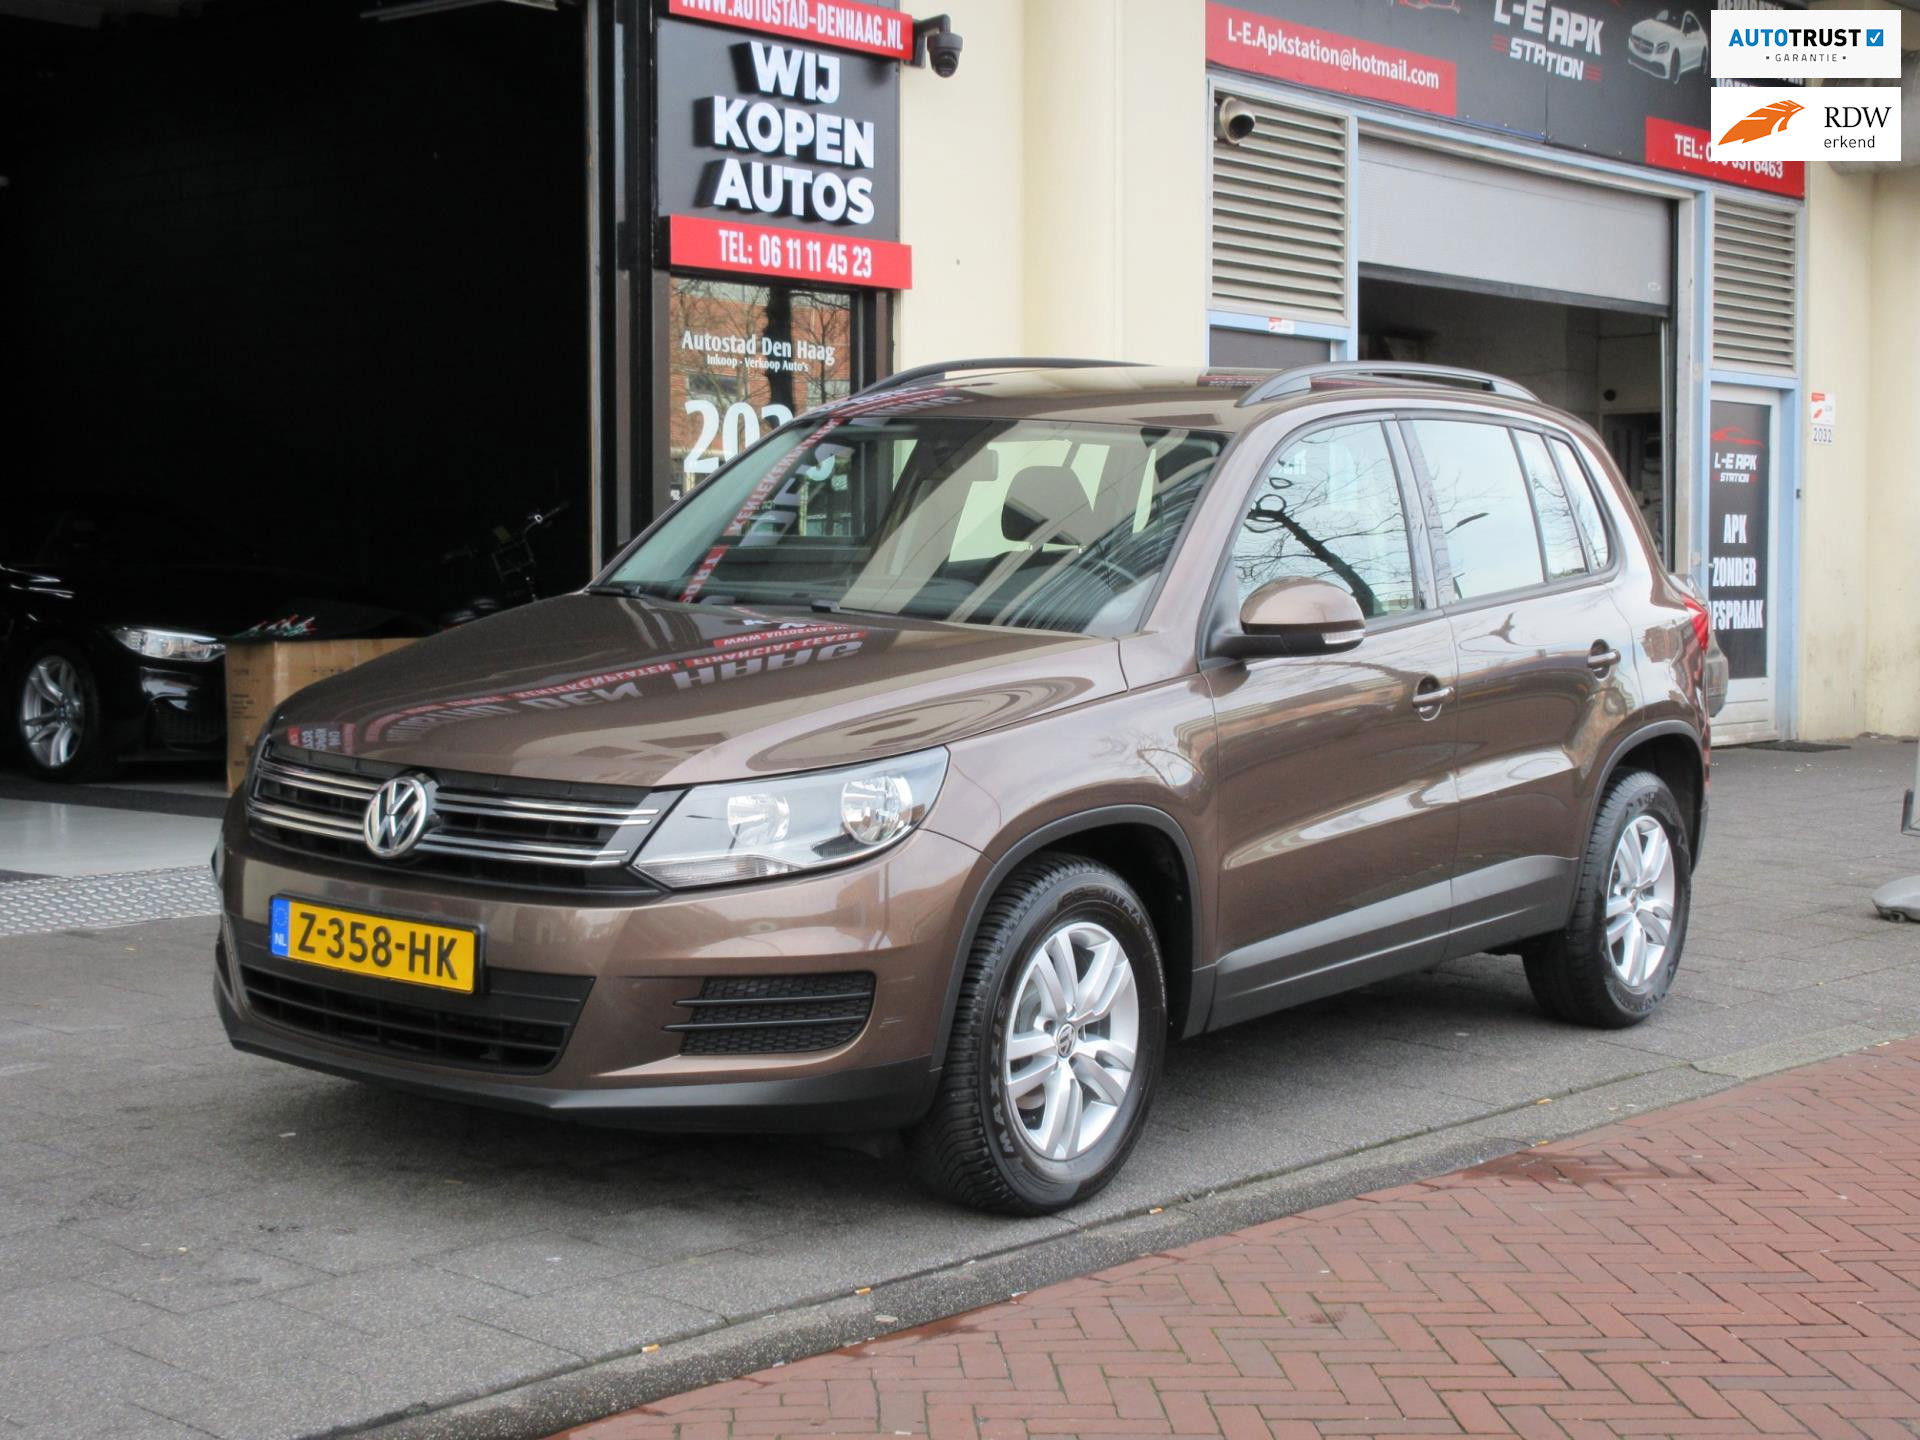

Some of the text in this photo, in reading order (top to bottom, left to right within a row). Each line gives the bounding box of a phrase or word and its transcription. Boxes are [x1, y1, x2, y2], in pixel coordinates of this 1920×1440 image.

[1493, 0, 1604, 55] L-E APK
[750, 40, 840, 104] WIJ
[1227, 17, 1440, 90] L-E.Apkstation@hotmail.com
[1509, 37, 1585, 81] STATION
[713, 95, 875, 169] KOPEN
[1675, 134, 1703, 160] TEL:
[1732, 161, 1784, 179] 6463
[712, 157, 876, 225] AUTOS
[718, 229, 872, 279] TEL: 06 11 11 45 23
[681, 330, 835, 367] Autostad Den Haag
[706, 353, 738, 367] Inkoop
[744, 356, 781, 373] Verkoop
[782, 360, 809, 372] Auto's
[1813, 427, 1833, 443] 2032
[1714, 451, 1758, 471] L-E APK
[1723, 514, 1747, 544] APK
[1712, 557, 1757, 587] ZONDER
[1708, 599, 1764, 631] FSPRAAK
[274, 933, 287, 947] NL
[297, 911, 458, 981] Z-358-HK
